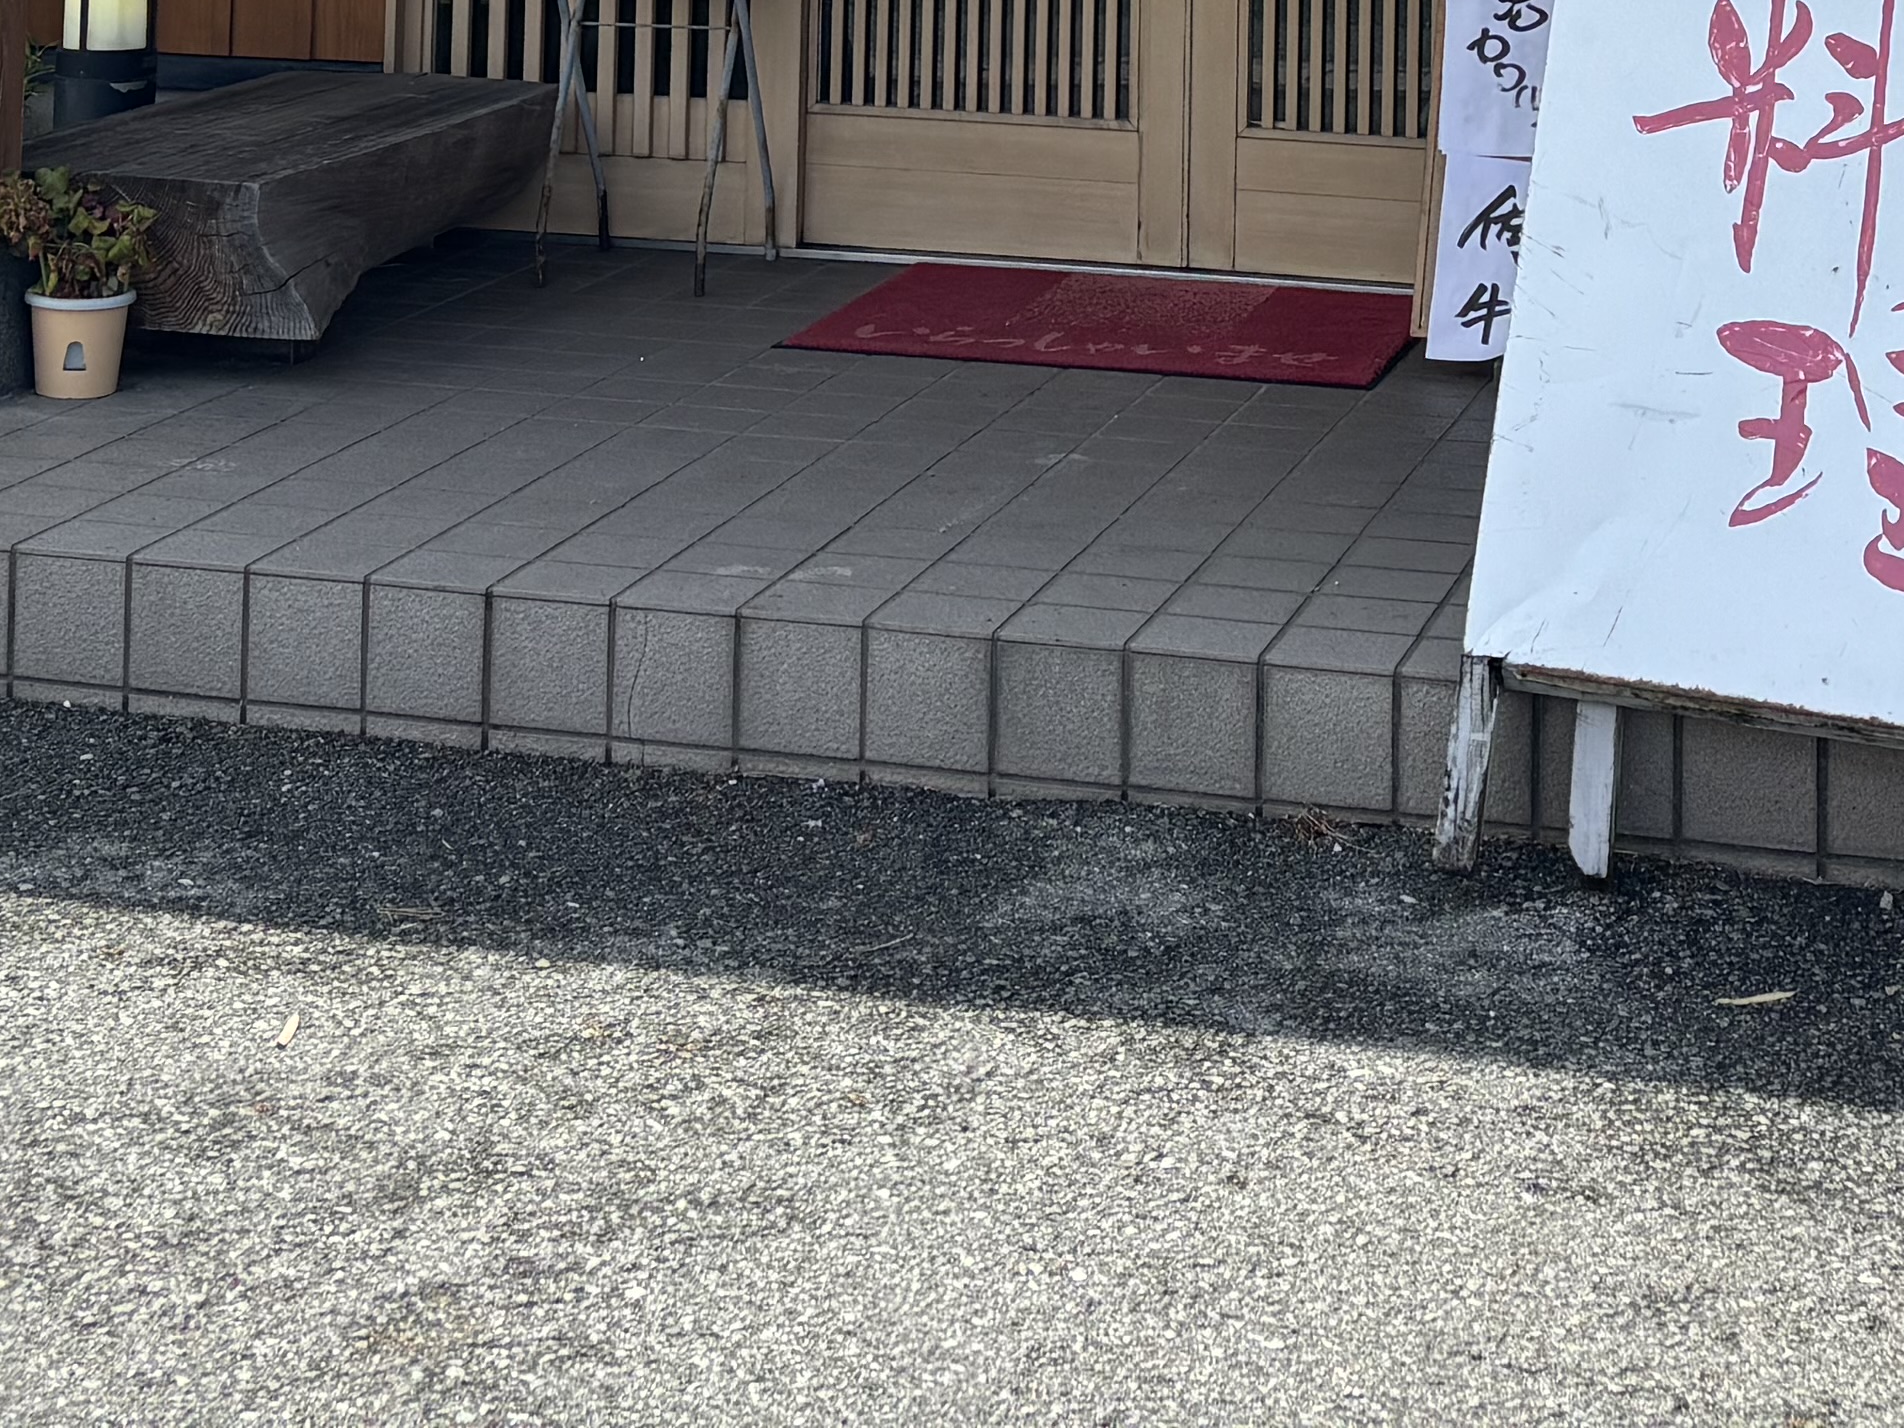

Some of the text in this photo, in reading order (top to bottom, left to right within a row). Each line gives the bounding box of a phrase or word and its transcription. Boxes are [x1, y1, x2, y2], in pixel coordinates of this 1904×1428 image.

[854, 321, 1339, 367] いらっしゃいませ
